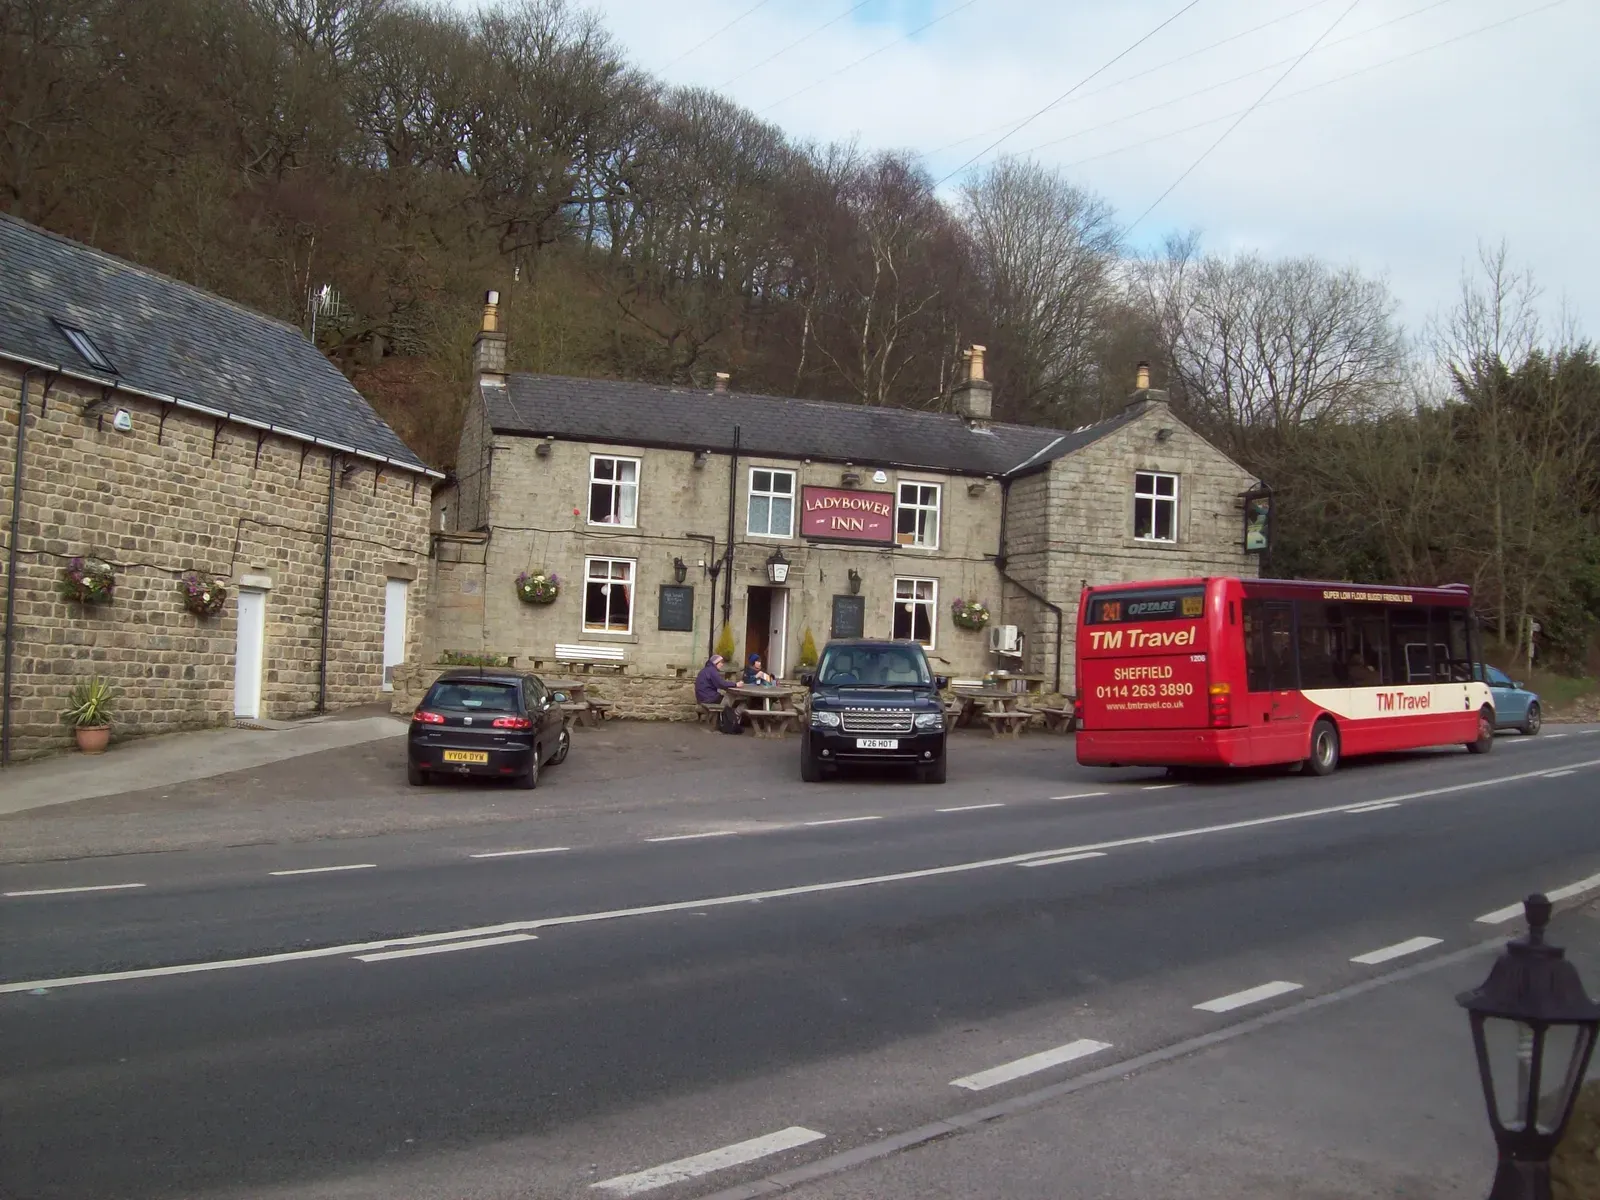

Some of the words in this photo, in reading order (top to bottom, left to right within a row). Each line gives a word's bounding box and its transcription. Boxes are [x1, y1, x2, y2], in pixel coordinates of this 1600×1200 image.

[805, 497, 890, 517] LADYBOWER
[830, 516, 864, 531] INN
[1323, 591, 1340, 599] SUPER
[1340, 592, 1351, 600] LOW
[1351, 592, 1367, 600] FLOOR
[1102, 601, 1121, 621] 241
[1128, 600, 1176, 615] OPTARE
[1090, 630, 1123, 650] TM
[1127, 626, 1196, 648] Travel
[1114, 666, 1173, 680] SHEFFIELD
[1096, 685, 1129, 698] 0114
[1131, 684, 1156, 697] 263
[1160, 682, 1193, 696] 3890
[1106, 700, 1184, 710] www.tmtravel.co.uk
[1376, 692, 1394, 711] TM
[1396, 691, 1430, 710] Travel
[878, 740, 893, 748] HOT
[448, 752, 468, 760] YY04
